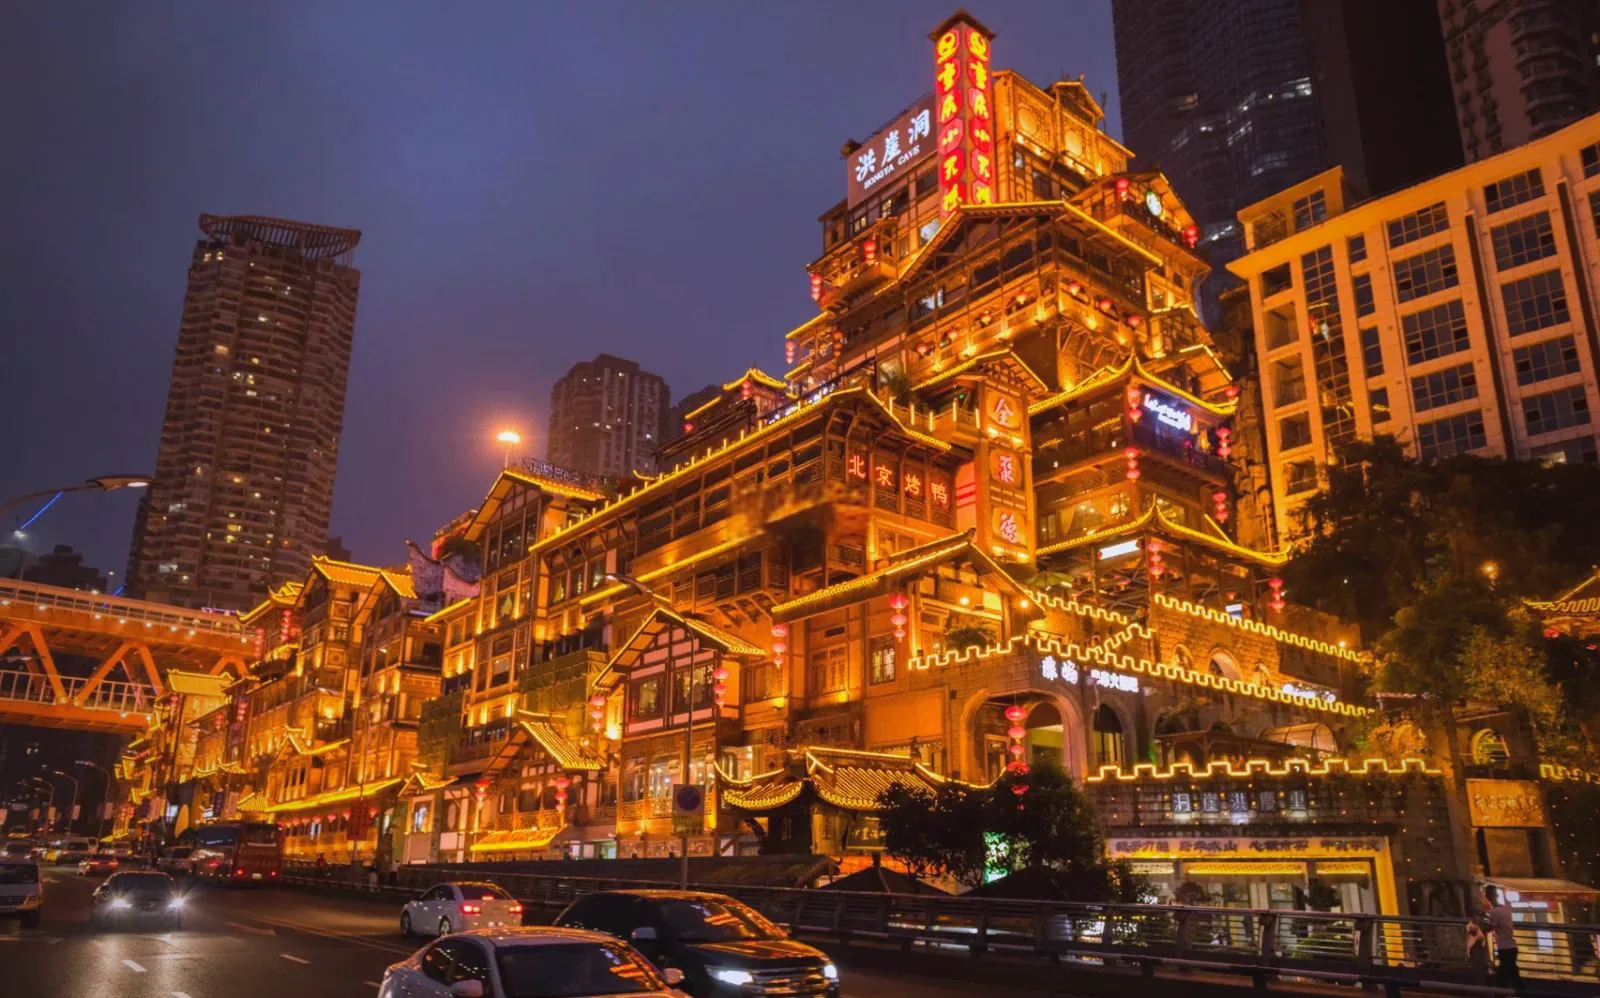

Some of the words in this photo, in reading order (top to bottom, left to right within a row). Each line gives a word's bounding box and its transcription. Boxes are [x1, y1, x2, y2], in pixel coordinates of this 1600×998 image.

[855, 108, 930, 182] 洪崖洞
[863, 163, 895, 190] HONGYA
[897, 144, 920, 166] CAVE
[848, 455, 948, 505] 北京烤鸭
[995, 398, 1018, 544] 全聚德
